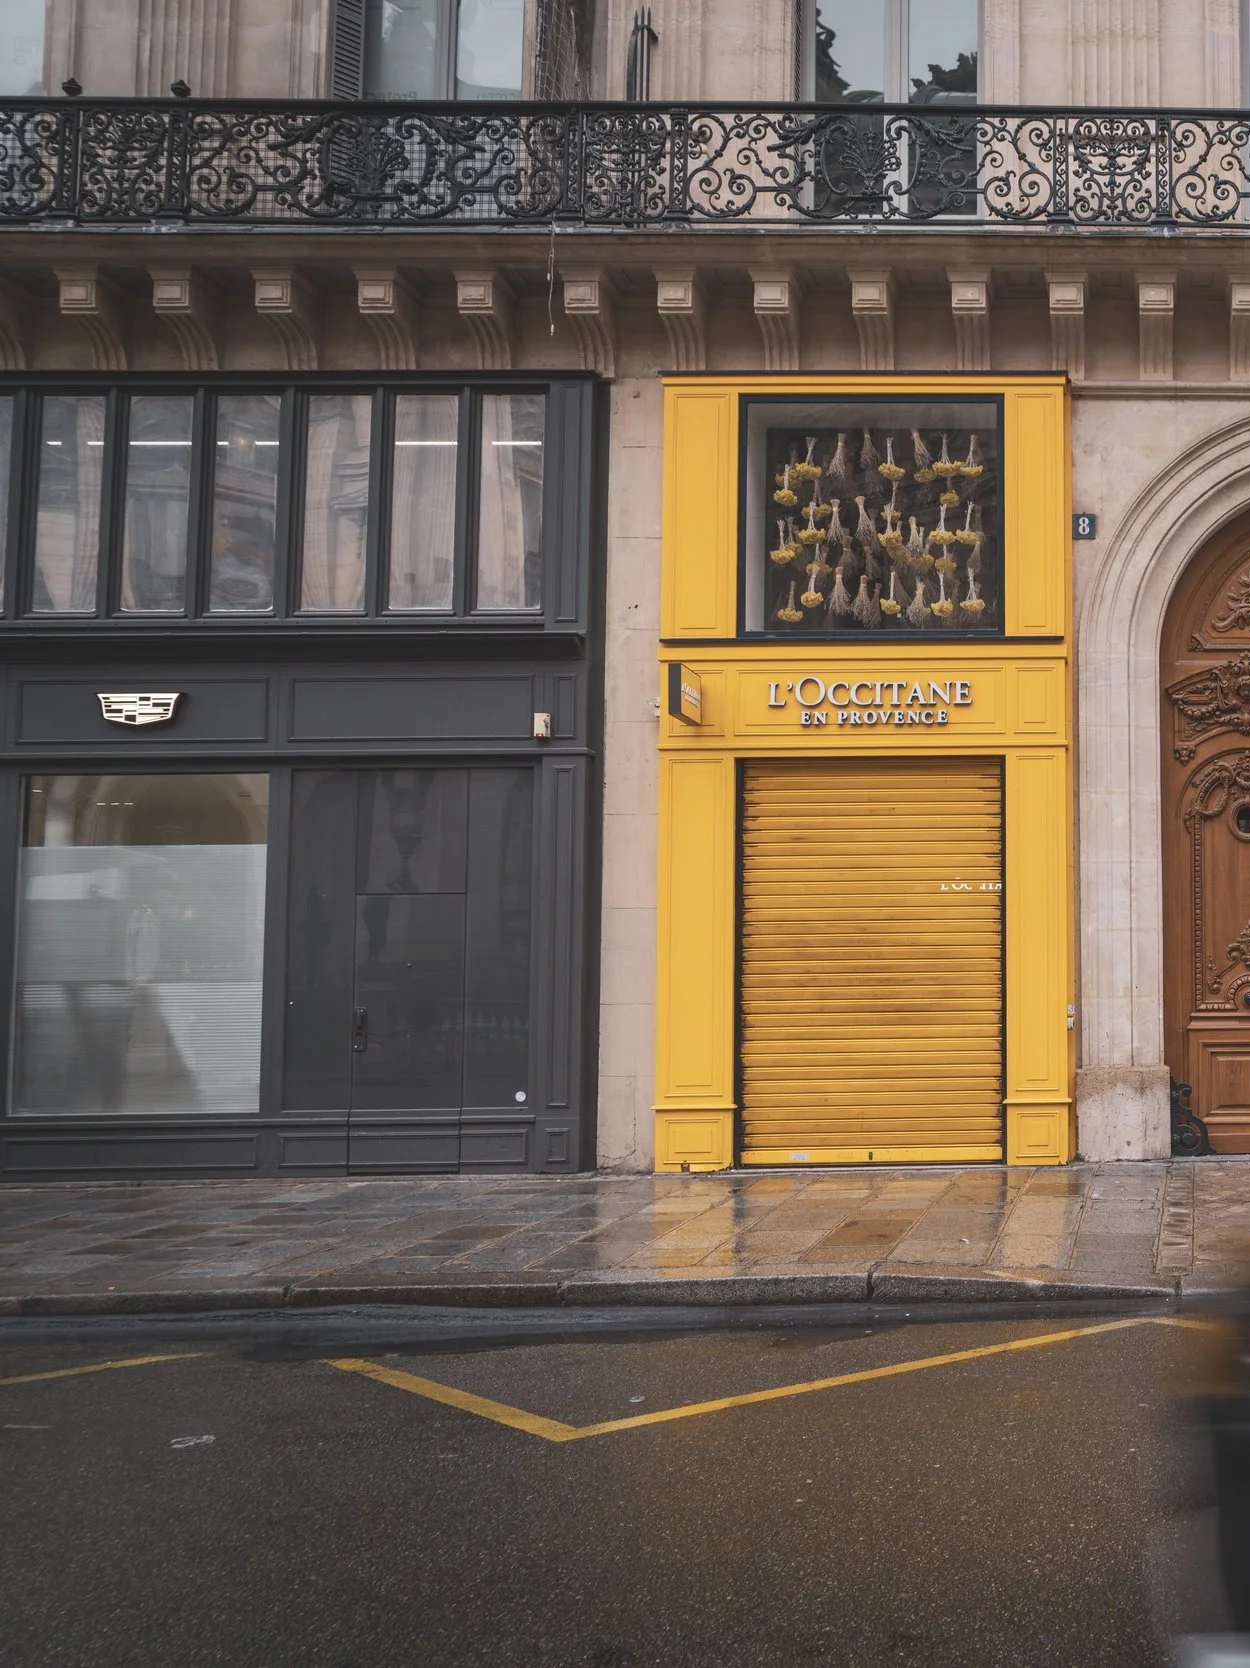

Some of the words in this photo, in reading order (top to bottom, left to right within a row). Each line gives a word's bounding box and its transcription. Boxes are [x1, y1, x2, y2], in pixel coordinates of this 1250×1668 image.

[1078, 516, 1090, 535] 8
[768, 677, 973, 706] L'OCCITANE
[800, 711, 828, 725] EN
[837, 709, 949, 725] PROVENCE
